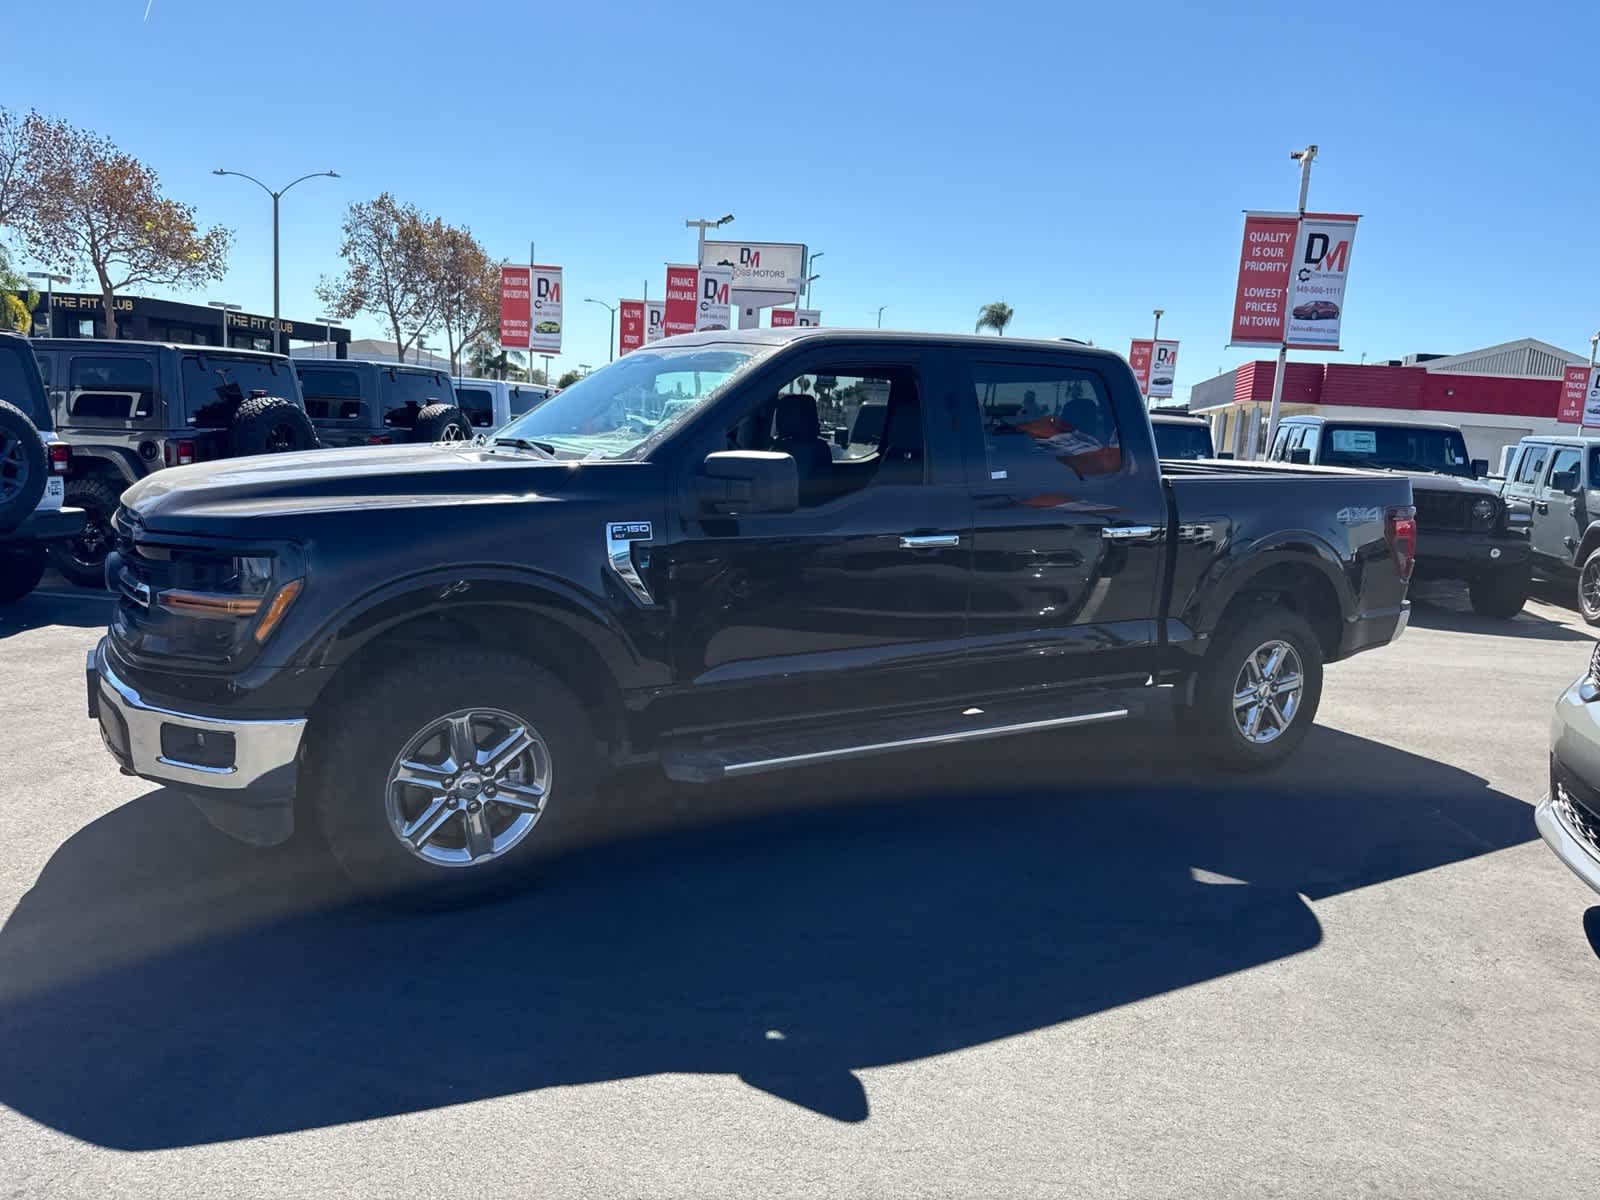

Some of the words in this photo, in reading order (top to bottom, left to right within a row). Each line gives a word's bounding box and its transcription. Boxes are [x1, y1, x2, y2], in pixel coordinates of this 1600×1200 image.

[1249, 231, 1292, 243] QUALITY
[1252, 247, 1261, 257] IS
[1263, 247, 1284, 257] OUR
[1245, 261, 1288, 272] PRIORITY
[753, 270, 785, 279] MOTORS
[671, 277, 695, 287] FINANCE
[667, 291, 697, 301] AVAILABLE
[1244, 287, 1282, 298] LOWEST
[52, 296, 77, 308] THE
[80, 298, 99, 309] FIT
[102, 299, 133, 311] UB
[1246, 302, 1277, 313] PRICES
[226, 313, 248, 327] THE
[251, 317, 267, 329] FIT
[269, 320, 293, 333] CUB
[1240, 315, 1249, 326] IN
[1252, 316, 1280, 327] TOWN
[613, 525, 649, 533] F-150
